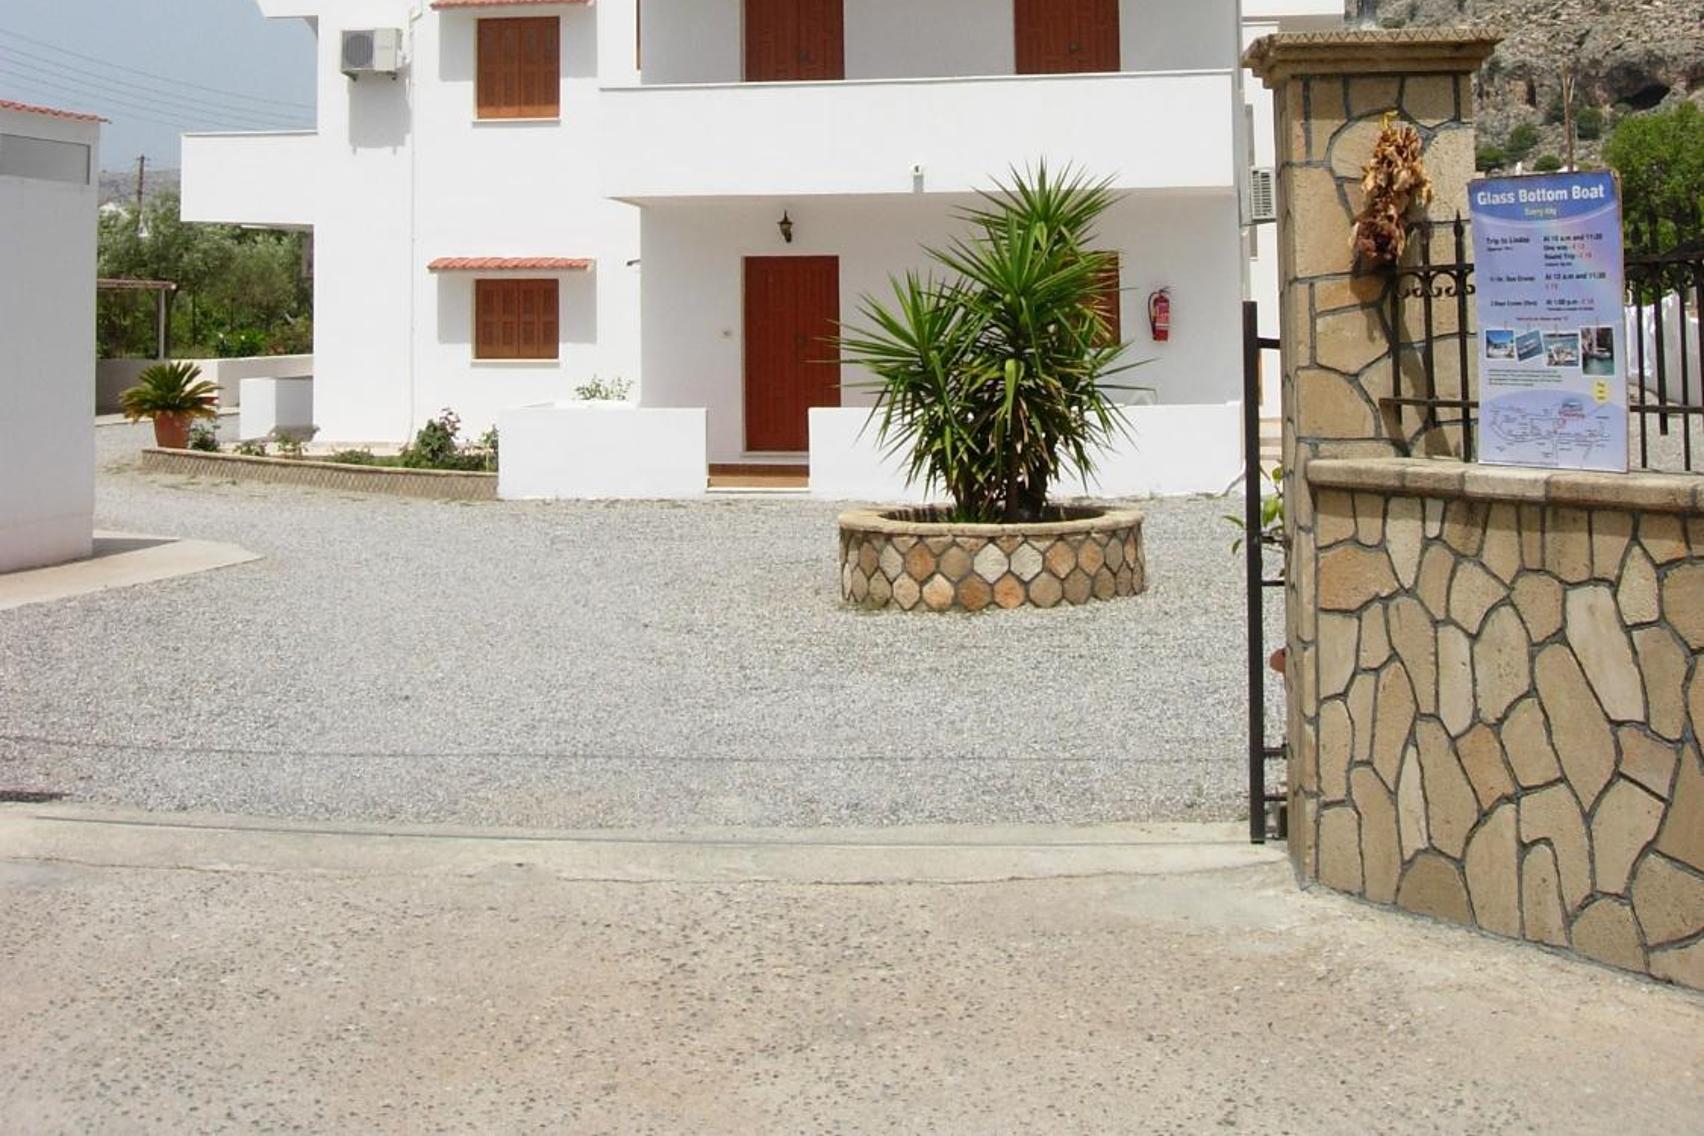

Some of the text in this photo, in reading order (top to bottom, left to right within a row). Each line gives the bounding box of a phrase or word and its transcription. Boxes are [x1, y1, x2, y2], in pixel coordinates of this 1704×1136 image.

[1477, 184, 1605, 206] Glass Bottom Boat
